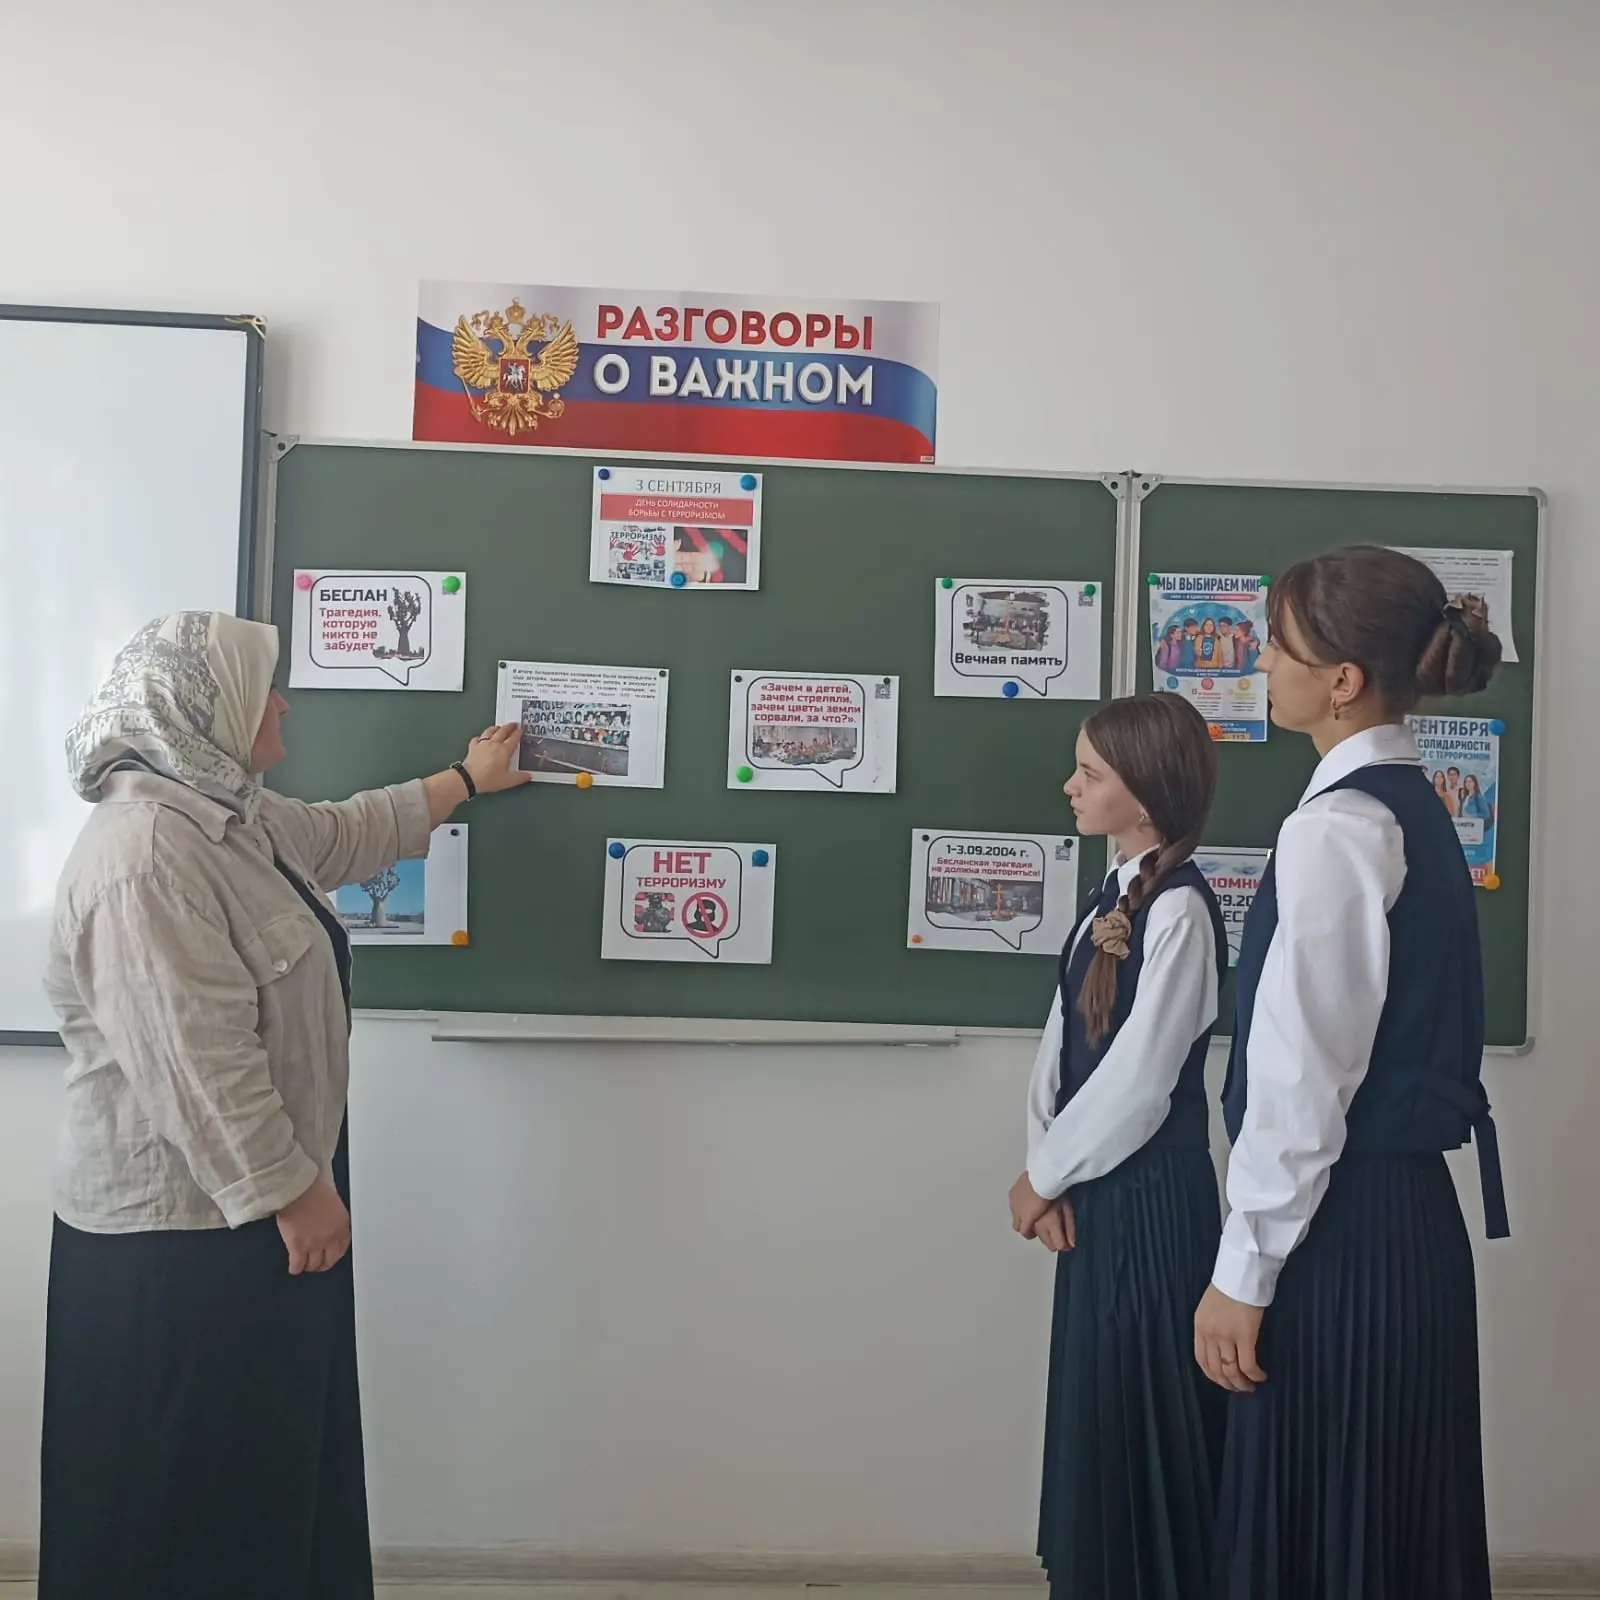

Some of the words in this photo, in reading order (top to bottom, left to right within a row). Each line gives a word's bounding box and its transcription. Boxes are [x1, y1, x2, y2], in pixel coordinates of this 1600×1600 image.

[597, 305, 872, 350] РАЗГОВОРЫ
[594, 354, 630, 394] О
[650, 356, 873, 406] ВАЖНОМ
[636, 479, 644, 491] 3
[647, 480, 721, 494] СЕНТЯБРЯ
[635, 499, 657, 508] ДЕНЬ
[657, 500, 719, 509] СОЛИДАРНОСТИ
[628, 509, 660, 517] БОРЬБЫ
[668, 510, 725, 519] ТЕРРОРИЗМОМ
[1157, 576, 1176, 591] МЫ
[1179, 577, 1239, 592] ВЫБИРАЕМ
[320, 589, 388, 602] БЕСЛАН
[323, 620, 377, 630] которую
[322, 631, 359, 639] никто
[362, 631, 378, 639] не
[955, 652, 1006, 665] Вечная
[1011, 656, 1063, 666] память
[761, 682, 803, 693] «Зачем
[806, 685, 813, 693] в
[760, 694, 794, 702] зачем
[751, 703, 785, 712] зачем
[788, 704, 823, 713] цветы
[826, 706, 861, 714] земли
[754, 713, 803, 723] сорвали,
[1410, 719, 1489, 737] СЕНТЯБРЯ
[1417, 739, 1491, 751] СОЛИДАРНОСТИ
[946, 844, 1017, 857] 1-3.09.2004
[1019, 848, 1029, 858] г.
[653, 851, 712, 874] НЕТ
[937, 857, 990, 868] Бесланская
[992, 860, 1033, 870] трагедия
[944, 867, 980, 876] должна
[981, 868, 1041, 878] повториться!
[636, 877, 727, 889] ТЕРРОРИЗМУ
